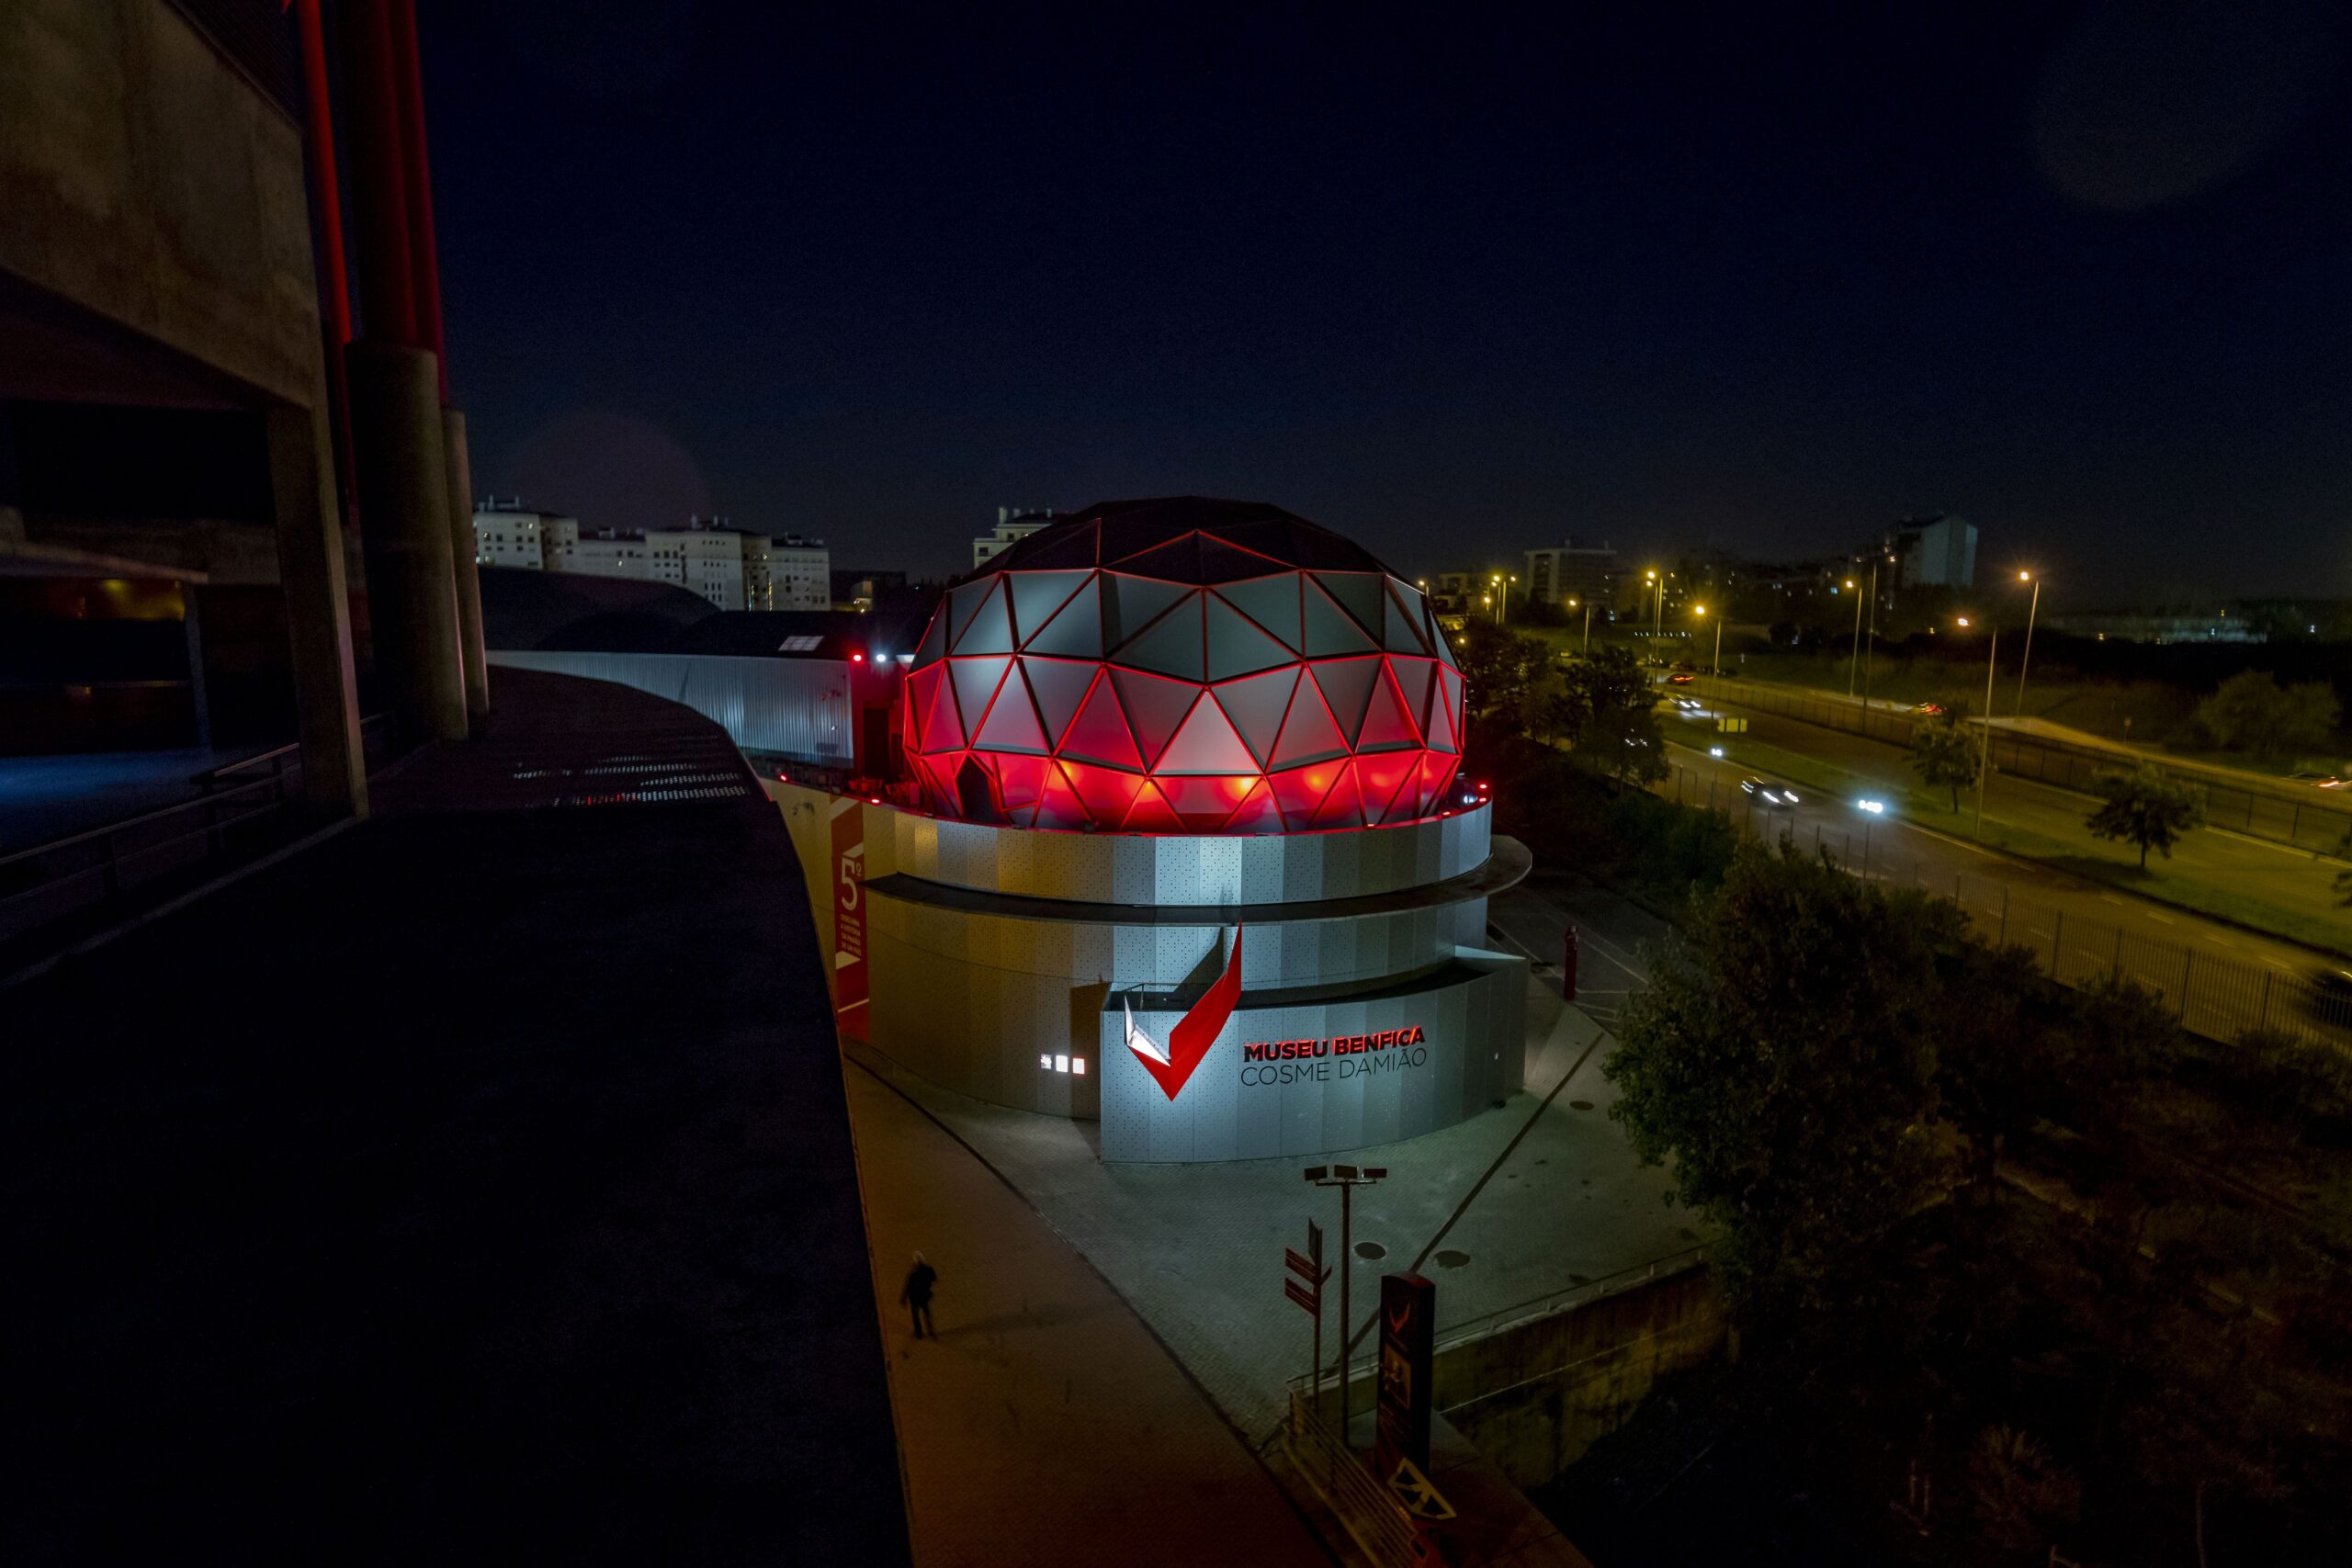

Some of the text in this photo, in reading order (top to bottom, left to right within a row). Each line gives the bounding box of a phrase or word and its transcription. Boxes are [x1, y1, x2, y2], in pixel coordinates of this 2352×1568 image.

[1244, 1025, 1425, 1063] MUSEU BENFICA
[1240, 1047, 1427, 1087] COSME DAMIÃO
